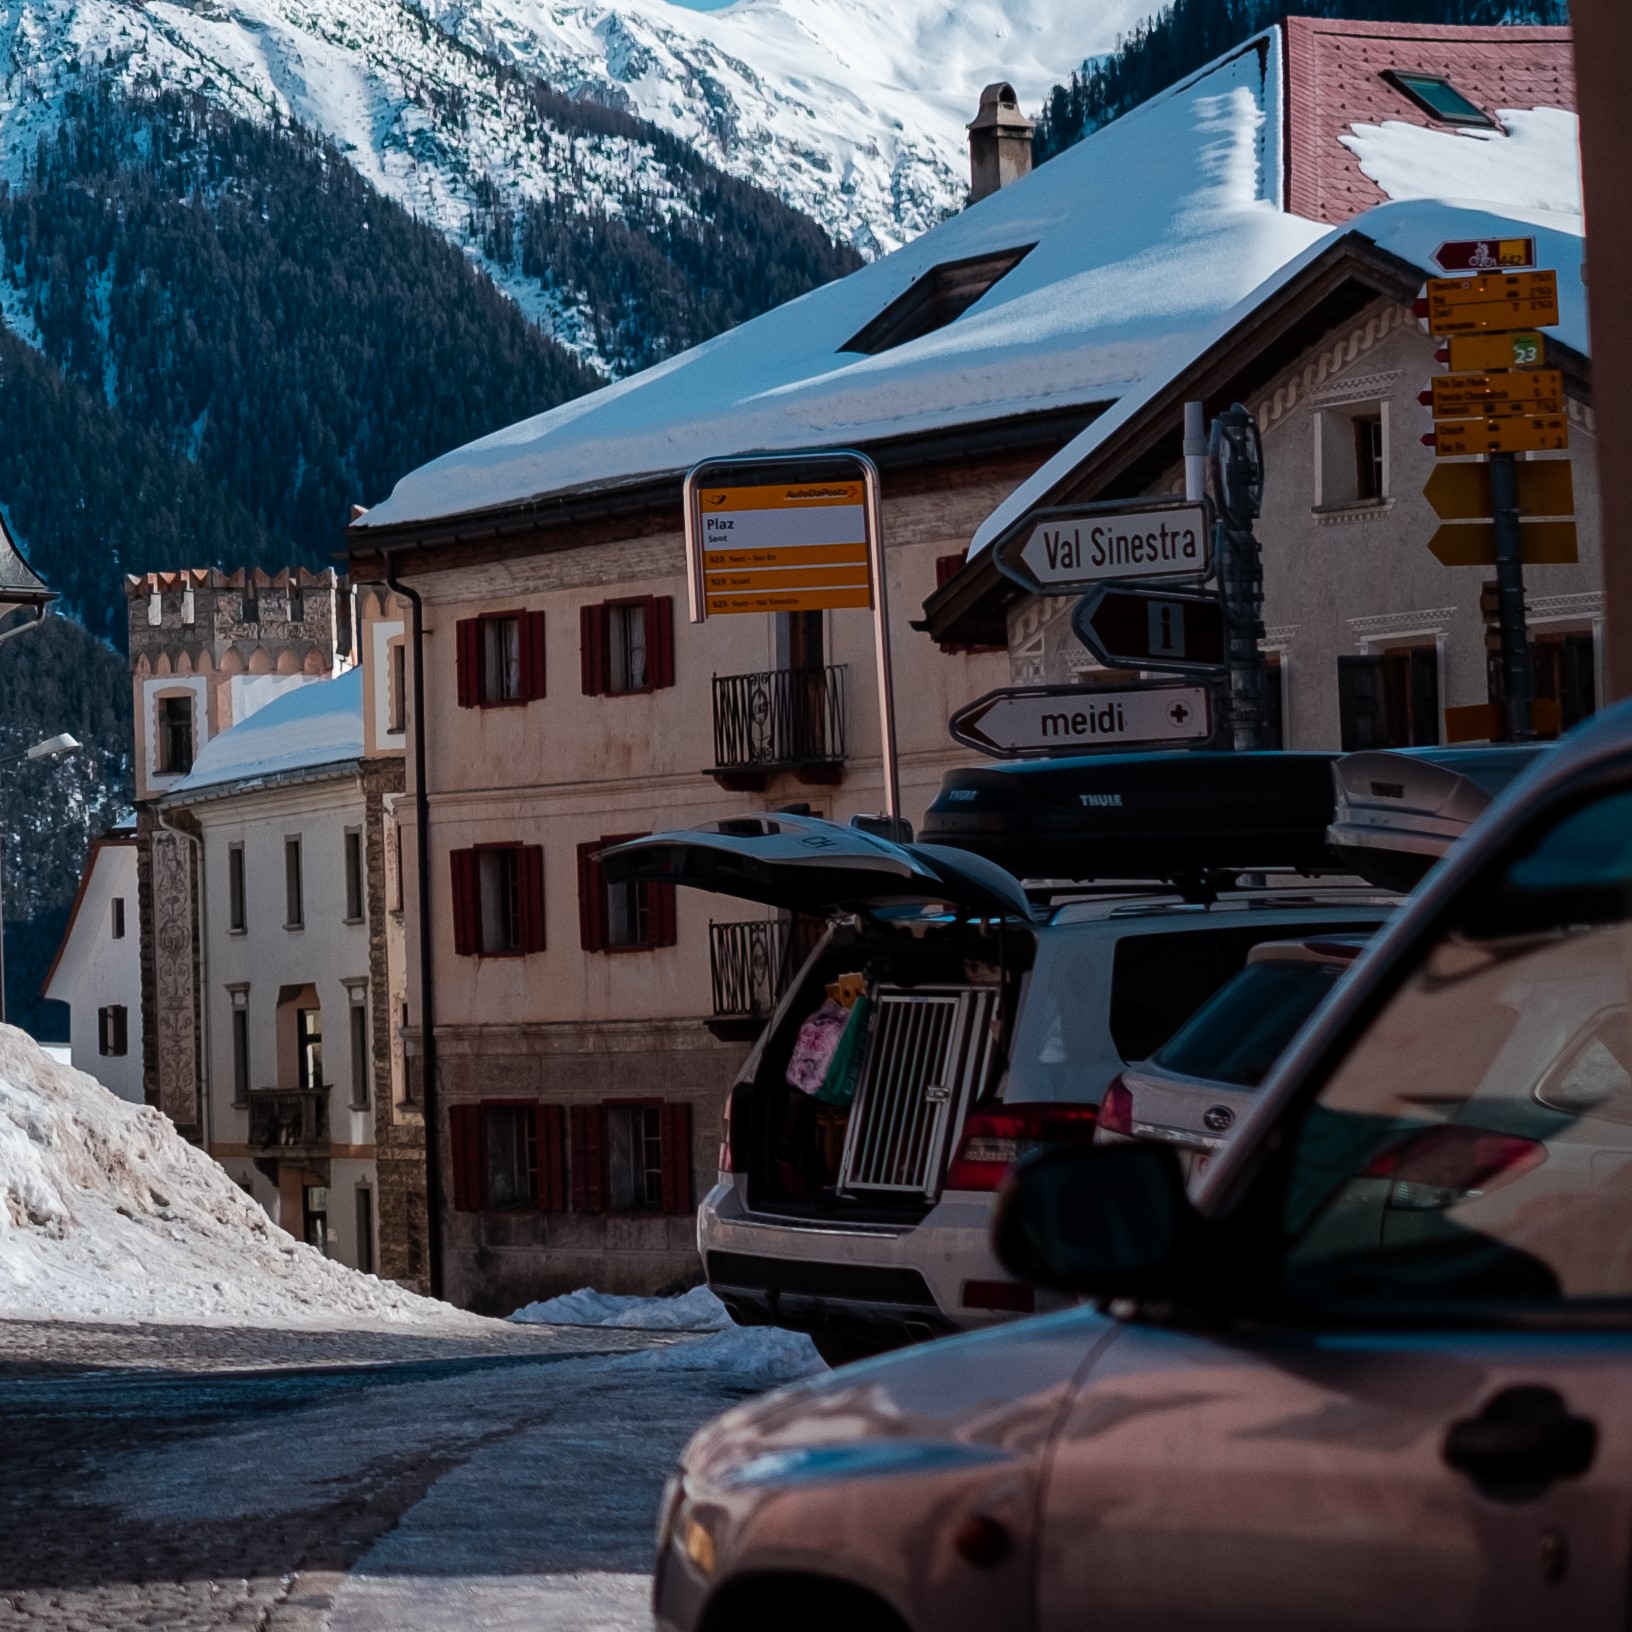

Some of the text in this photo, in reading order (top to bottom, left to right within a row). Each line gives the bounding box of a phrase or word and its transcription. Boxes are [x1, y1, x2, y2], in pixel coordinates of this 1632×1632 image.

[1515, 347, 1537, 364] 23
[707, 518, 735, 530] Plaz
[708, 534, 728, 543] Sent
[1043, 522, 1196, 570] Val Sinestra
[1041, 703, 1124, 737] meidi
[1079, 794, 1123, 807] THULE
[801, 836, 838, 849] CH
